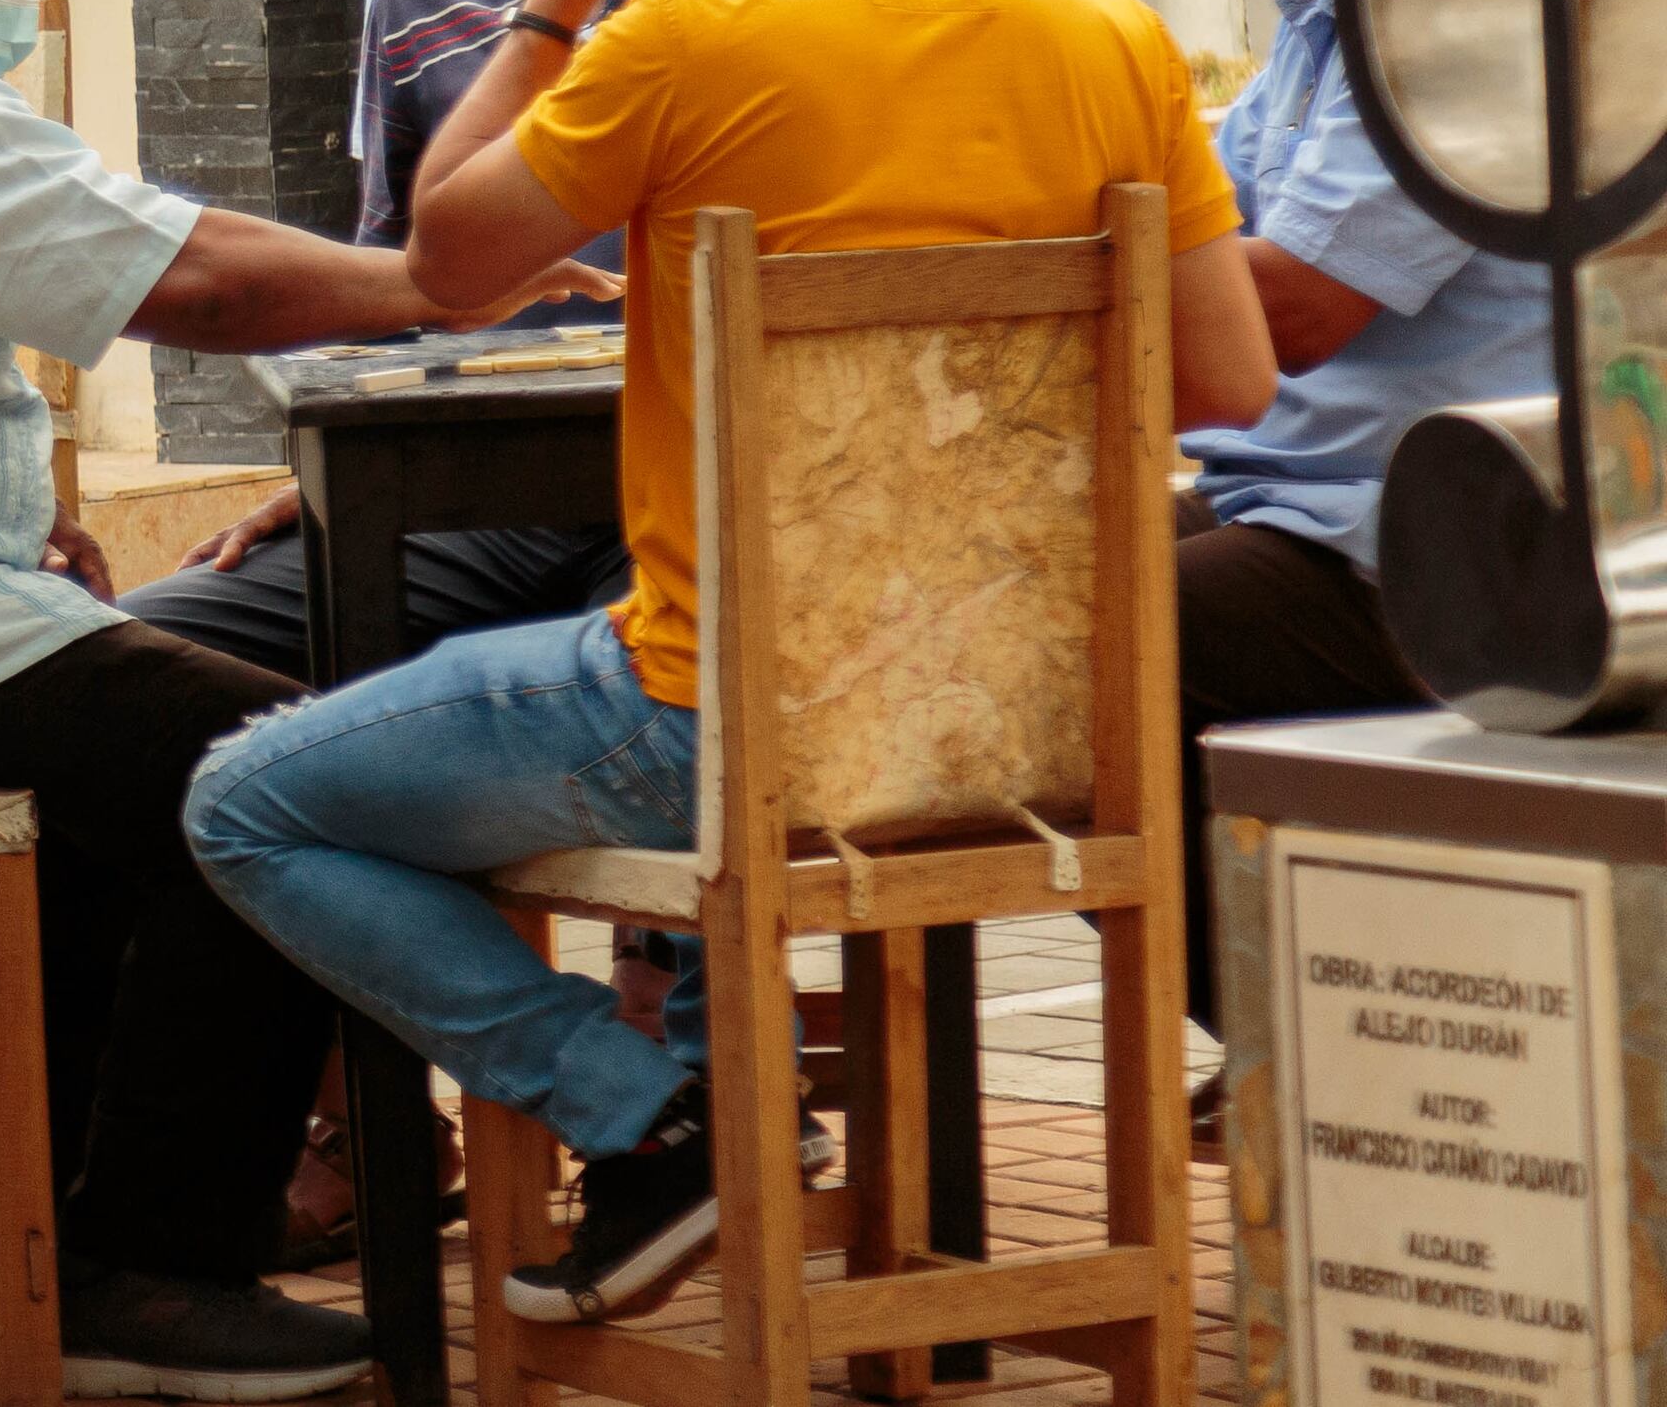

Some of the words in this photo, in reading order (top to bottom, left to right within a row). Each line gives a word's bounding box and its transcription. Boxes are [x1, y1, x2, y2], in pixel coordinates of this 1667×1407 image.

[1310, 953, 1384, 993] OBRA:
[1538, 983, 1571, 1019] DE
[1352, 1007, 1436, 1048] ALEJO
[1312, 1120, 1418, 1171] FRANCISCO
[1319, 1259, 1412, 1303] GILBERTO
